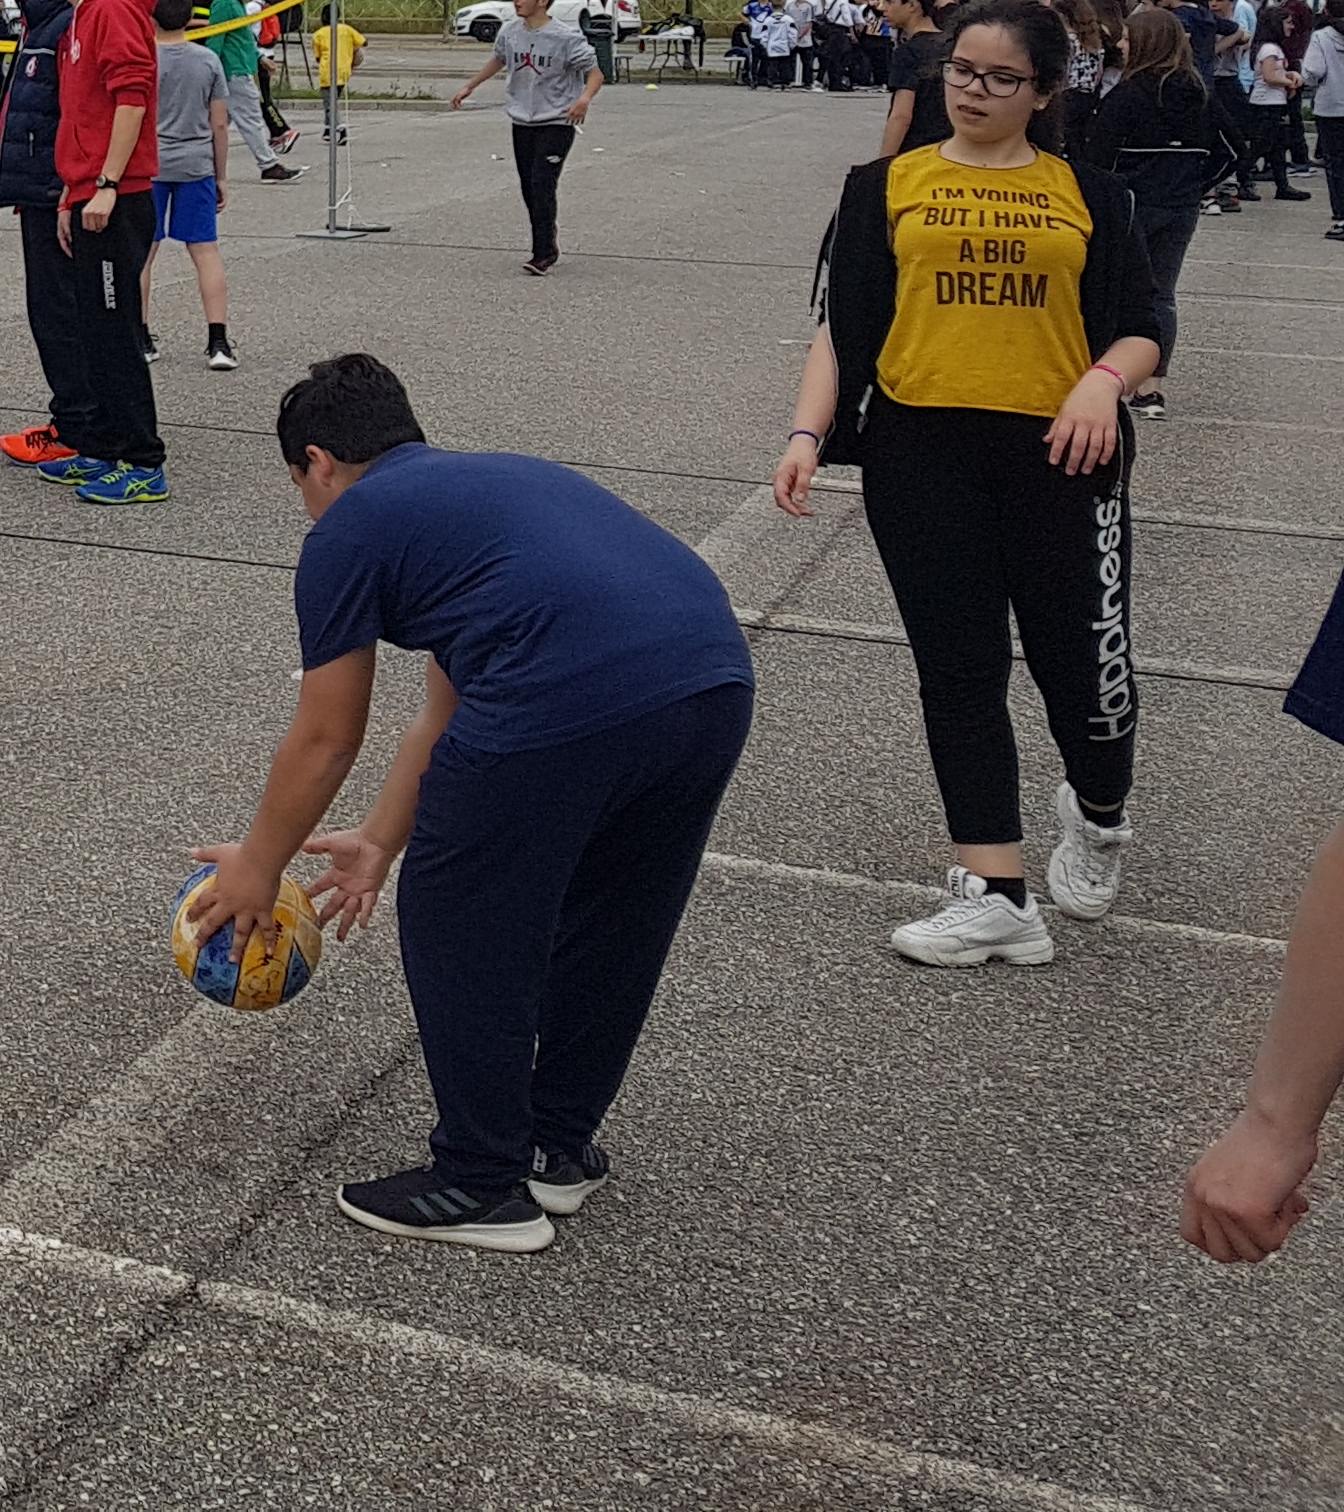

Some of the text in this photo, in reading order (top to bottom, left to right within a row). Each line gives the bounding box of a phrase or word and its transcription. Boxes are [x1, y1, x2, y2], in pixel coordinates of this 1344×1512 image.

[932, 187, 965, 200] I'M
[923, 207, 1060, 230] BUT I HAVE
[959, 238, 1027, 264] A BIG
[935, 271, 1049, 308] DREAM
[1088, 499, 1135, 741] Happiness
